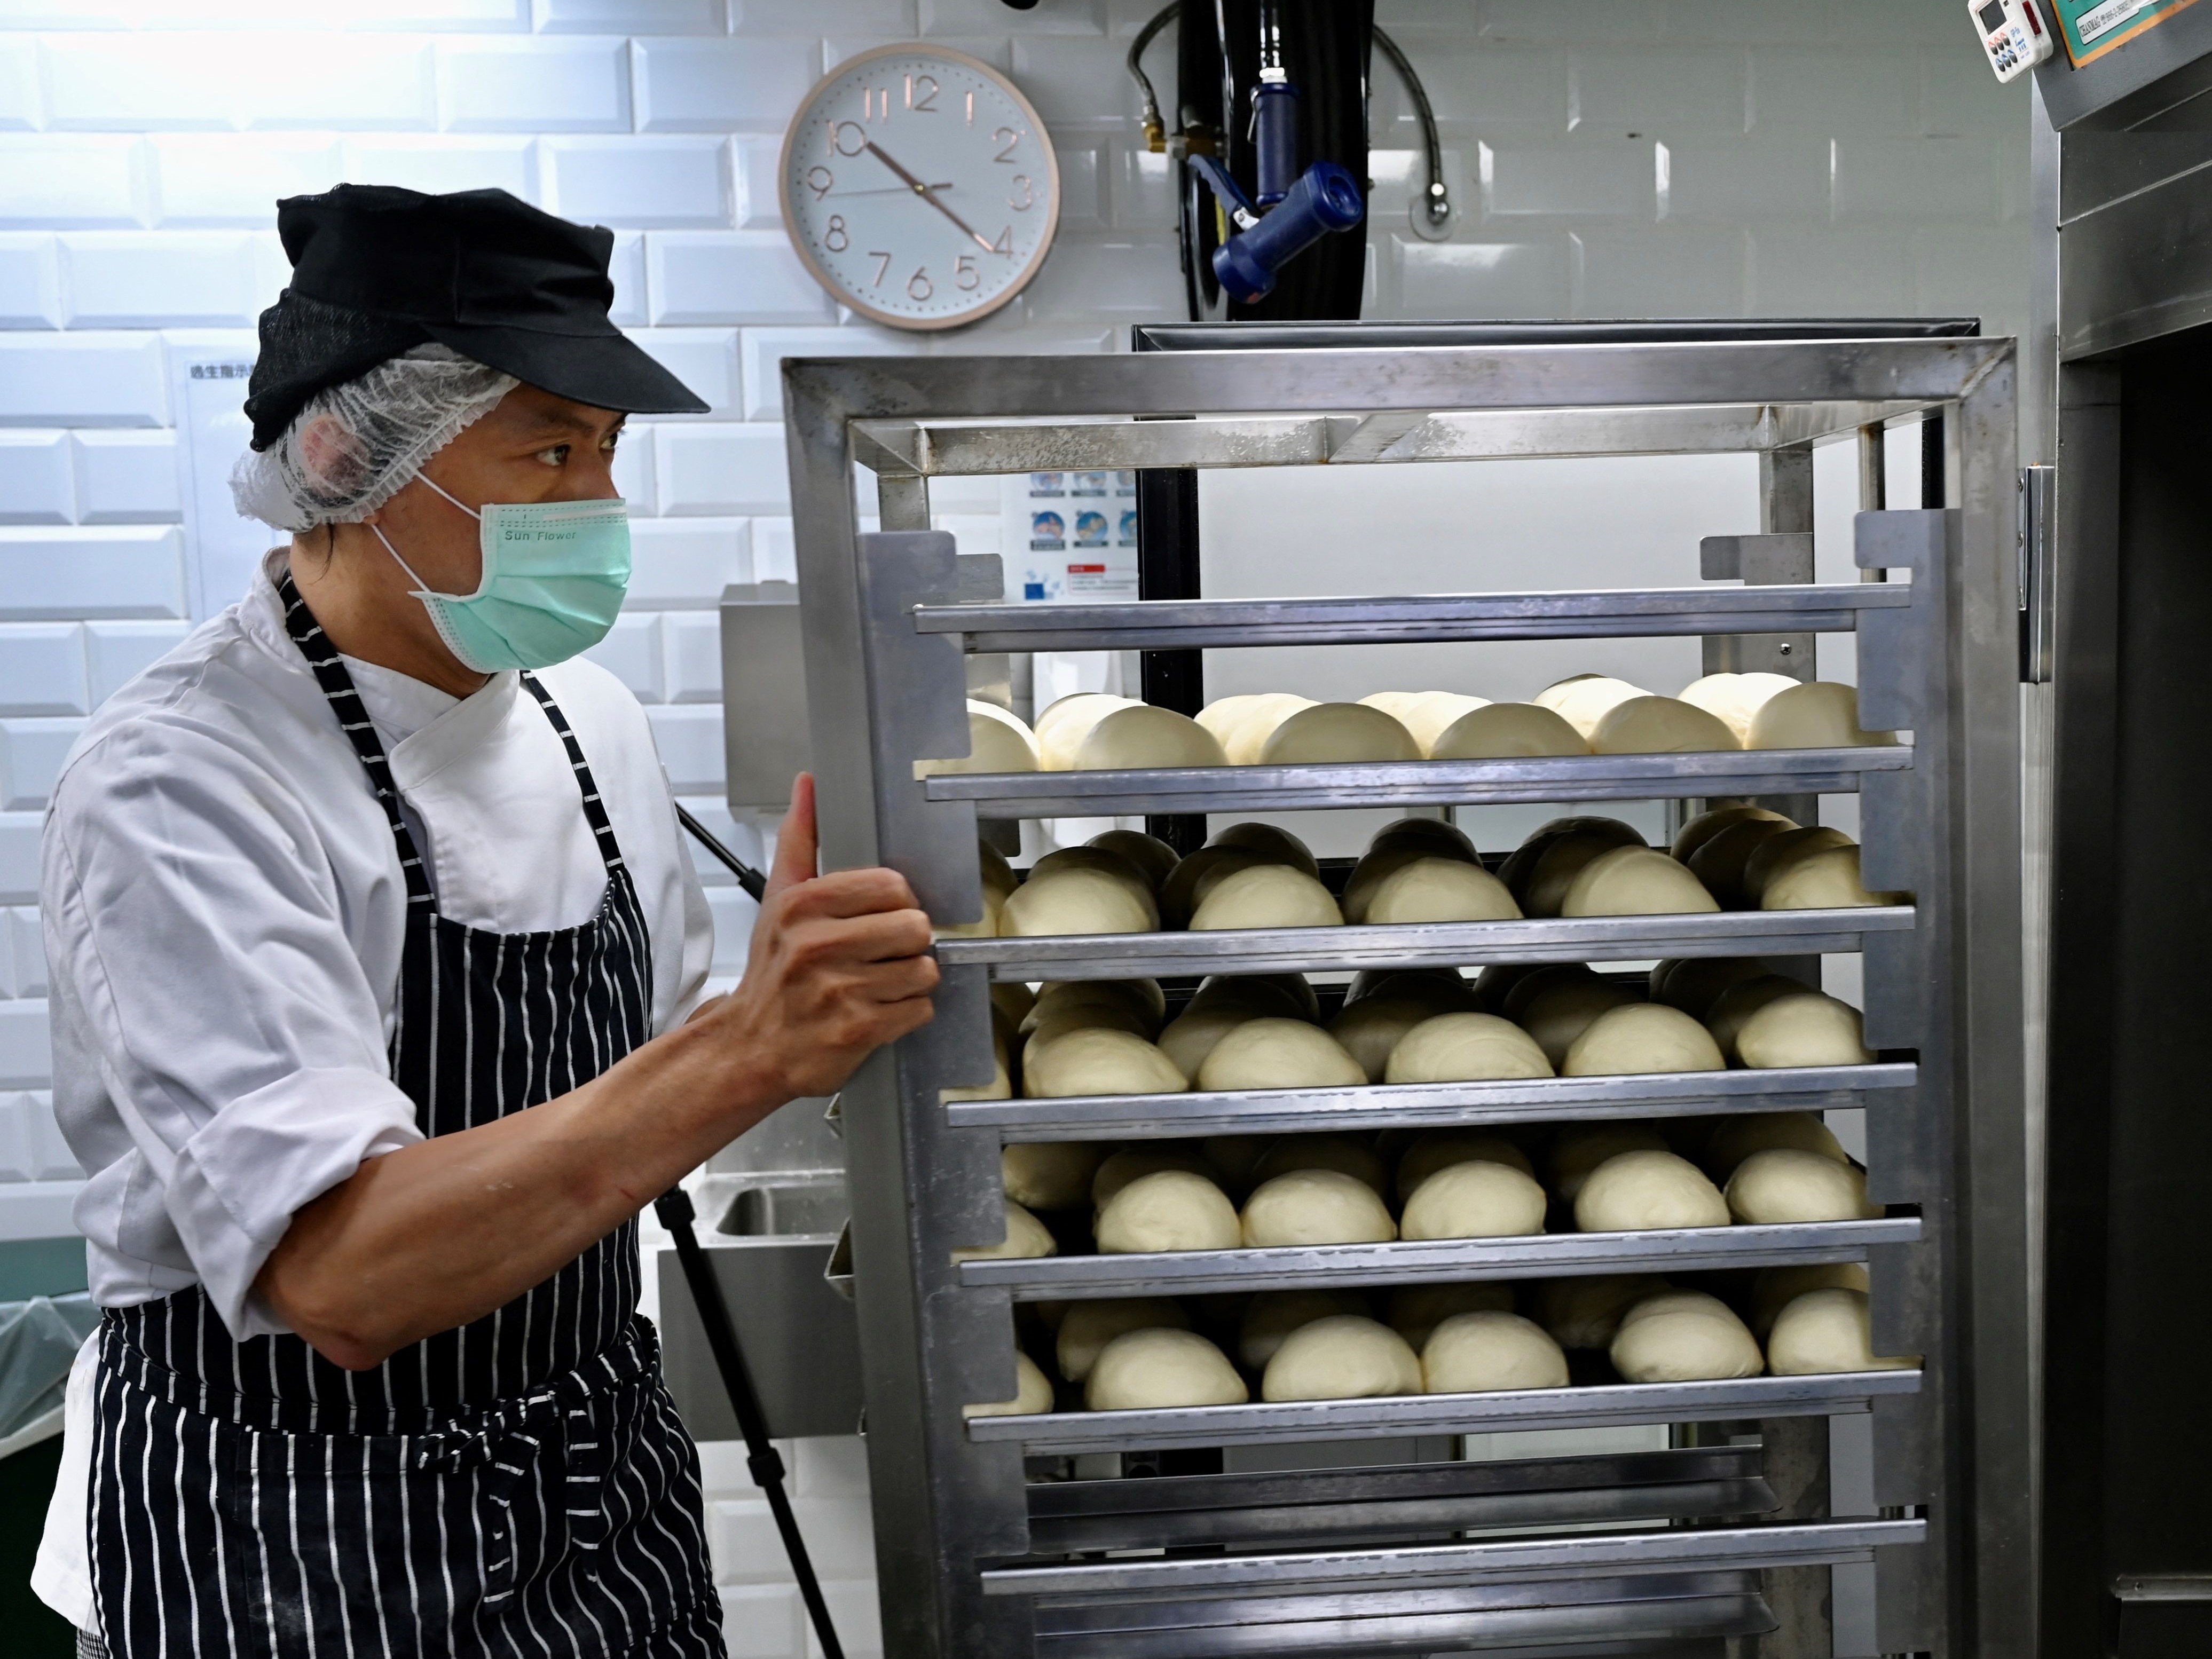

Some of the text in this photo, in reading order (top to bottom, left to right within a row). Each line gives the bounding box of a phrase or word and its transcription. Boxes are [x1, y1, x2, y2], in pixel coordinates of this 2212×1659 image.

[862, 86, 888, 123] 11
[904, 73, 940, 113] 12
[965, 90, 973, 128] 1
[826, 119, 868, 157] 10
[992, 127, 1018, 164] 2
[807, 165, 833, 201] 9
[1008, 175, 1033, 212] 3
[824, 215, 848, 253] 8
[992, 225, 1014, 259] 4
[868, 251, 892, 288] 7
[907, 266, 933, 302] 6
[955, 256, 980, 291] 5
[505, 530, 577, 541] Sun Flower
